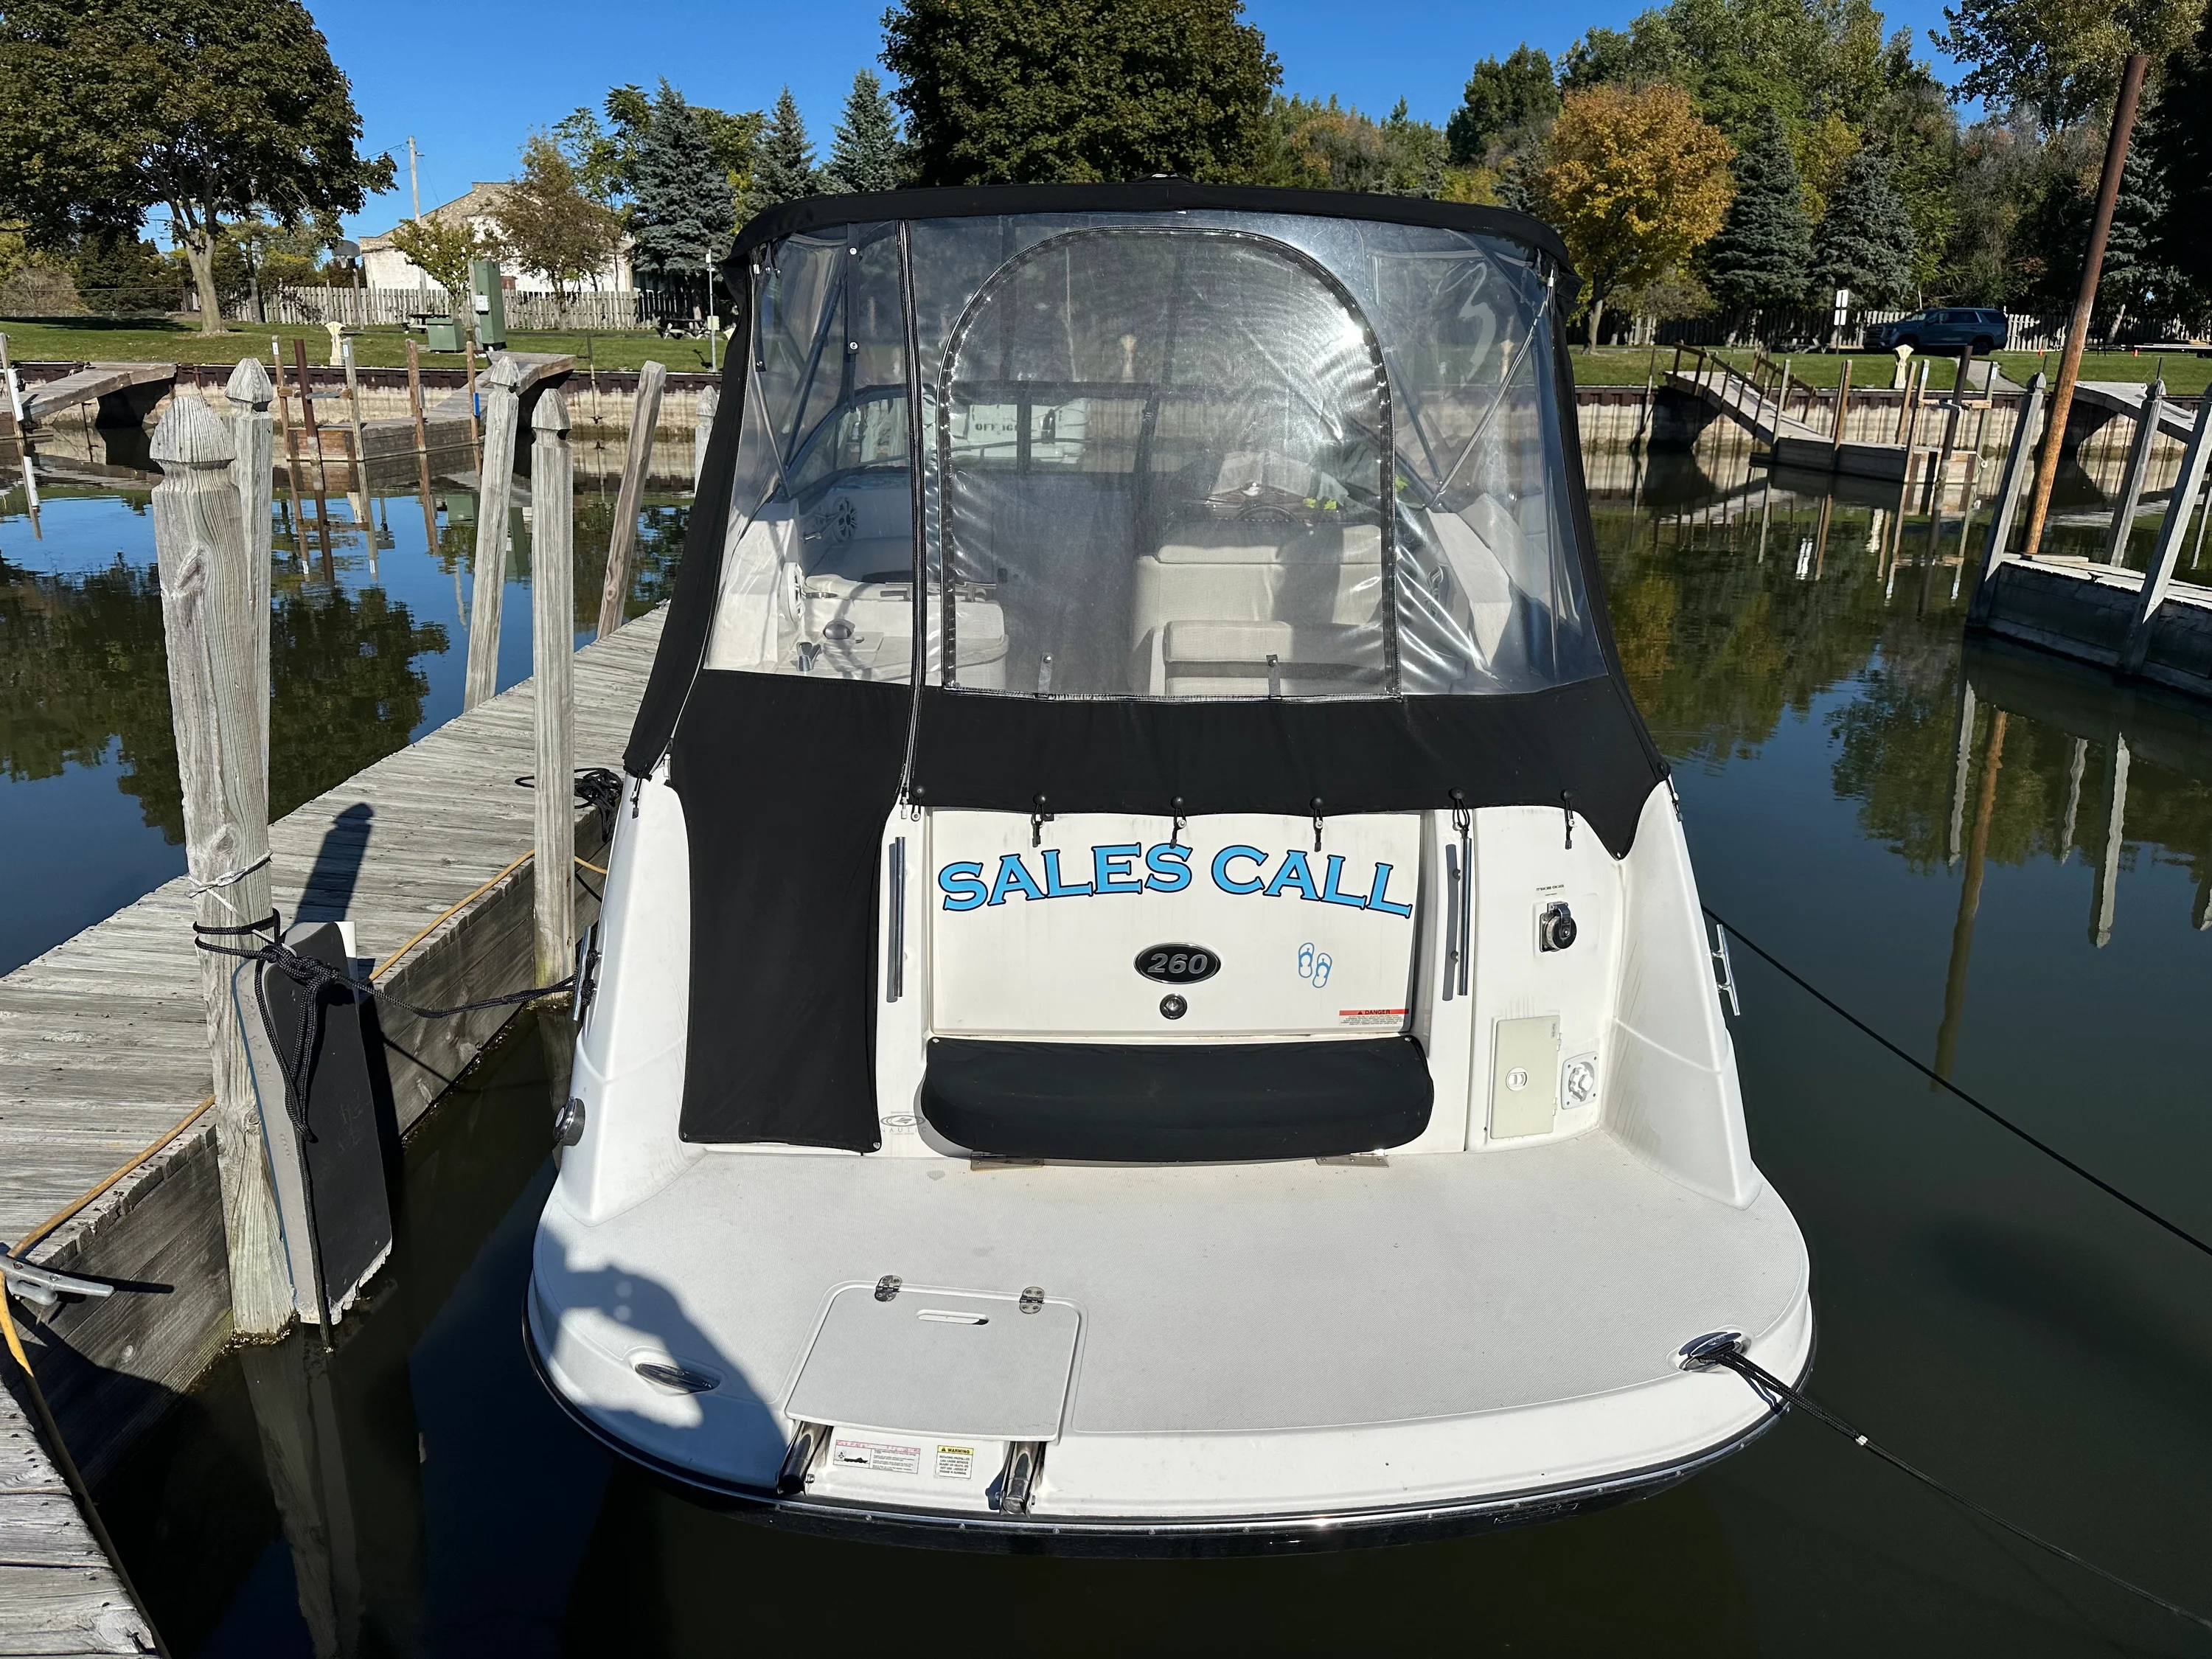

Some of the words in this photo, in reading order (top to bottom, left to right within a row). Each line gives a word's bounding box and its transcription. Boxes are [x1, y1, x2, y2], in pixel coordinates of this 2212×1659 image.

[975, 423, 998, 431] OFF
[938, 842, 1193, 912] SALES
[1211, 844, 1413, 919] CALL
[1147, 953, 1208, 974] 260
